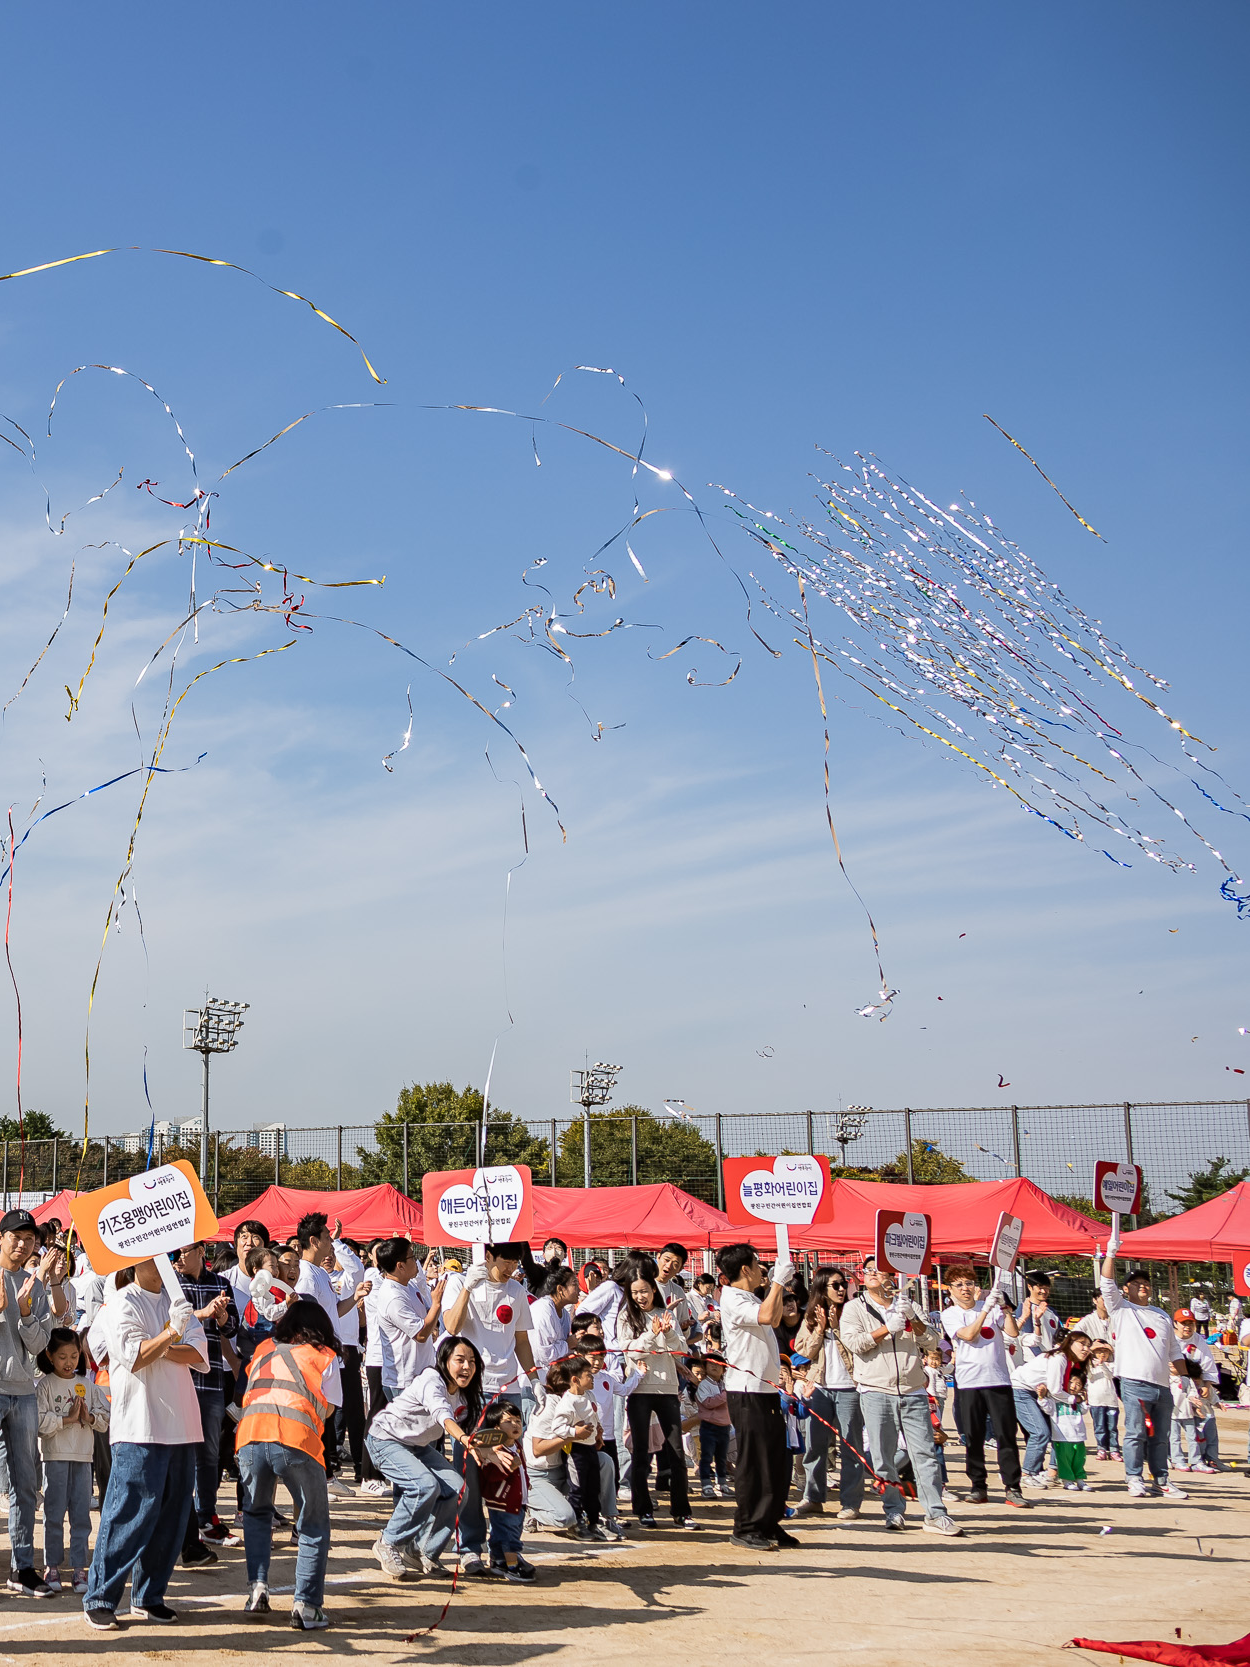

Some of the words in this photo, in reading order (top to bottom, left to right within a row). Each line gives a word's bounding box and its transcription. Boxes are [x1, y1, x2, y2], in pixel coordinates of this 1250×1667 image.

[742, 1181, 819, 1198] 늘평화어린이집
[98, 1190, 192, 1237] 키즈용맹어린이집
[118, 1216, 191, 1250] 광진구민간어린이집연합회
